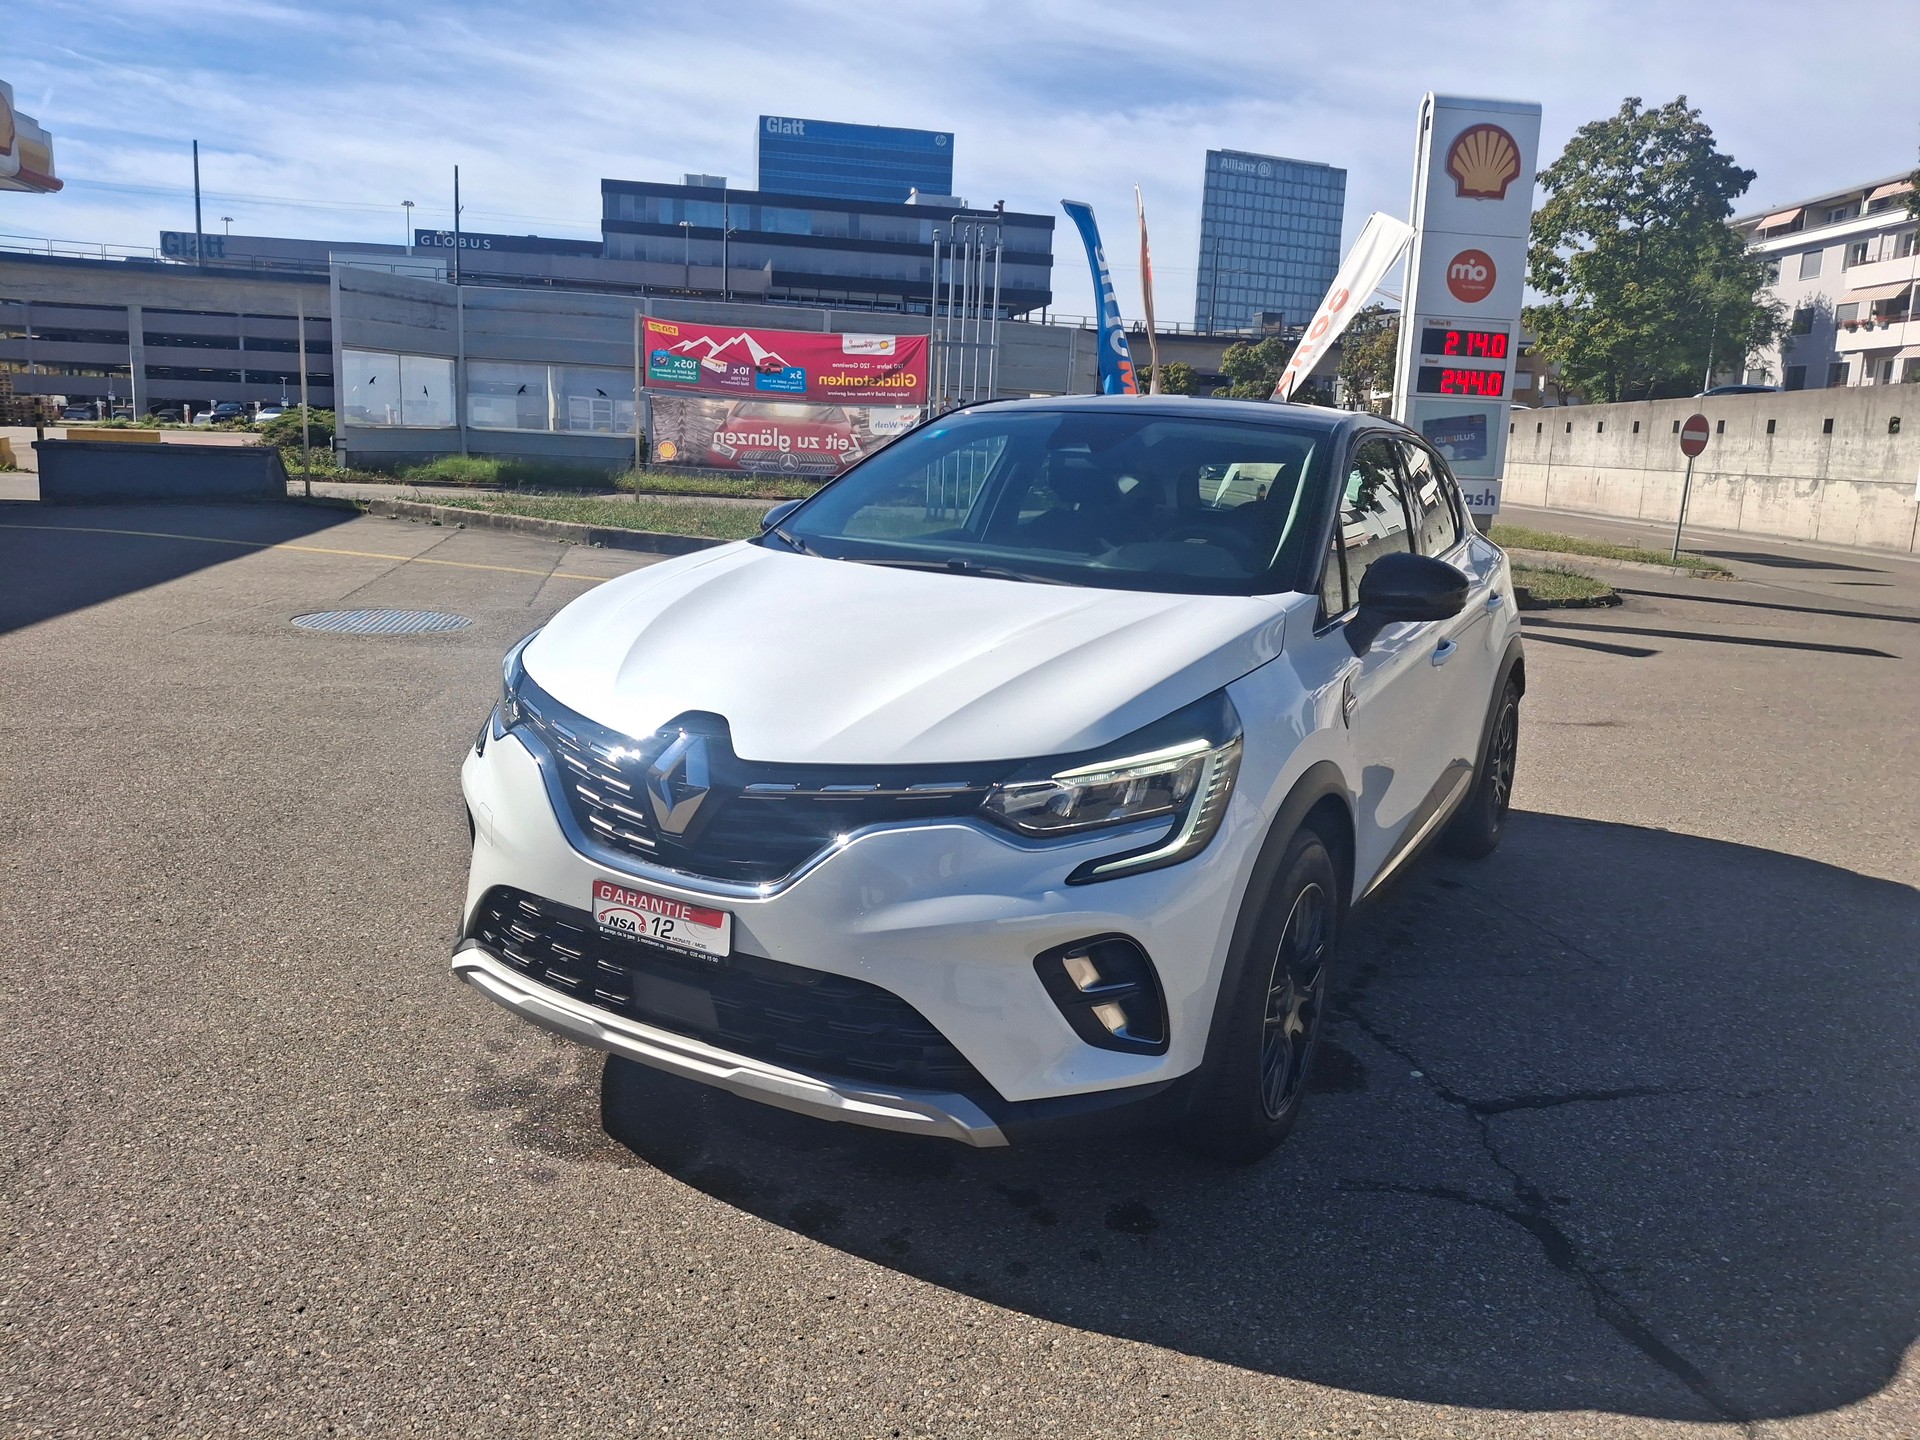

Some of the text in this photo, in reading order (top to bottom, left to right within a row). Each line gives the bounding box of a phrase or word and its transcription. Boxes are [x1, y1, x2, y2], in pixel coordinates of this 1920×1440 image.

[765, 116, 806, 136] Glatt
[935, 134, 947, 147] hp
[1220, 157, 1257, 173] Allianz
[420, 234, 491, 250] GLOBUS
[1450, 258, 1488, 282] mio
[1440, 369, 1503, 396] 244.0
[1462, 488, 1496, 506] ash
[600, 885, 692, 920] GARANTIE
[608, 915, 636, 932] NSA
[651, 917, 674, 940] 12
